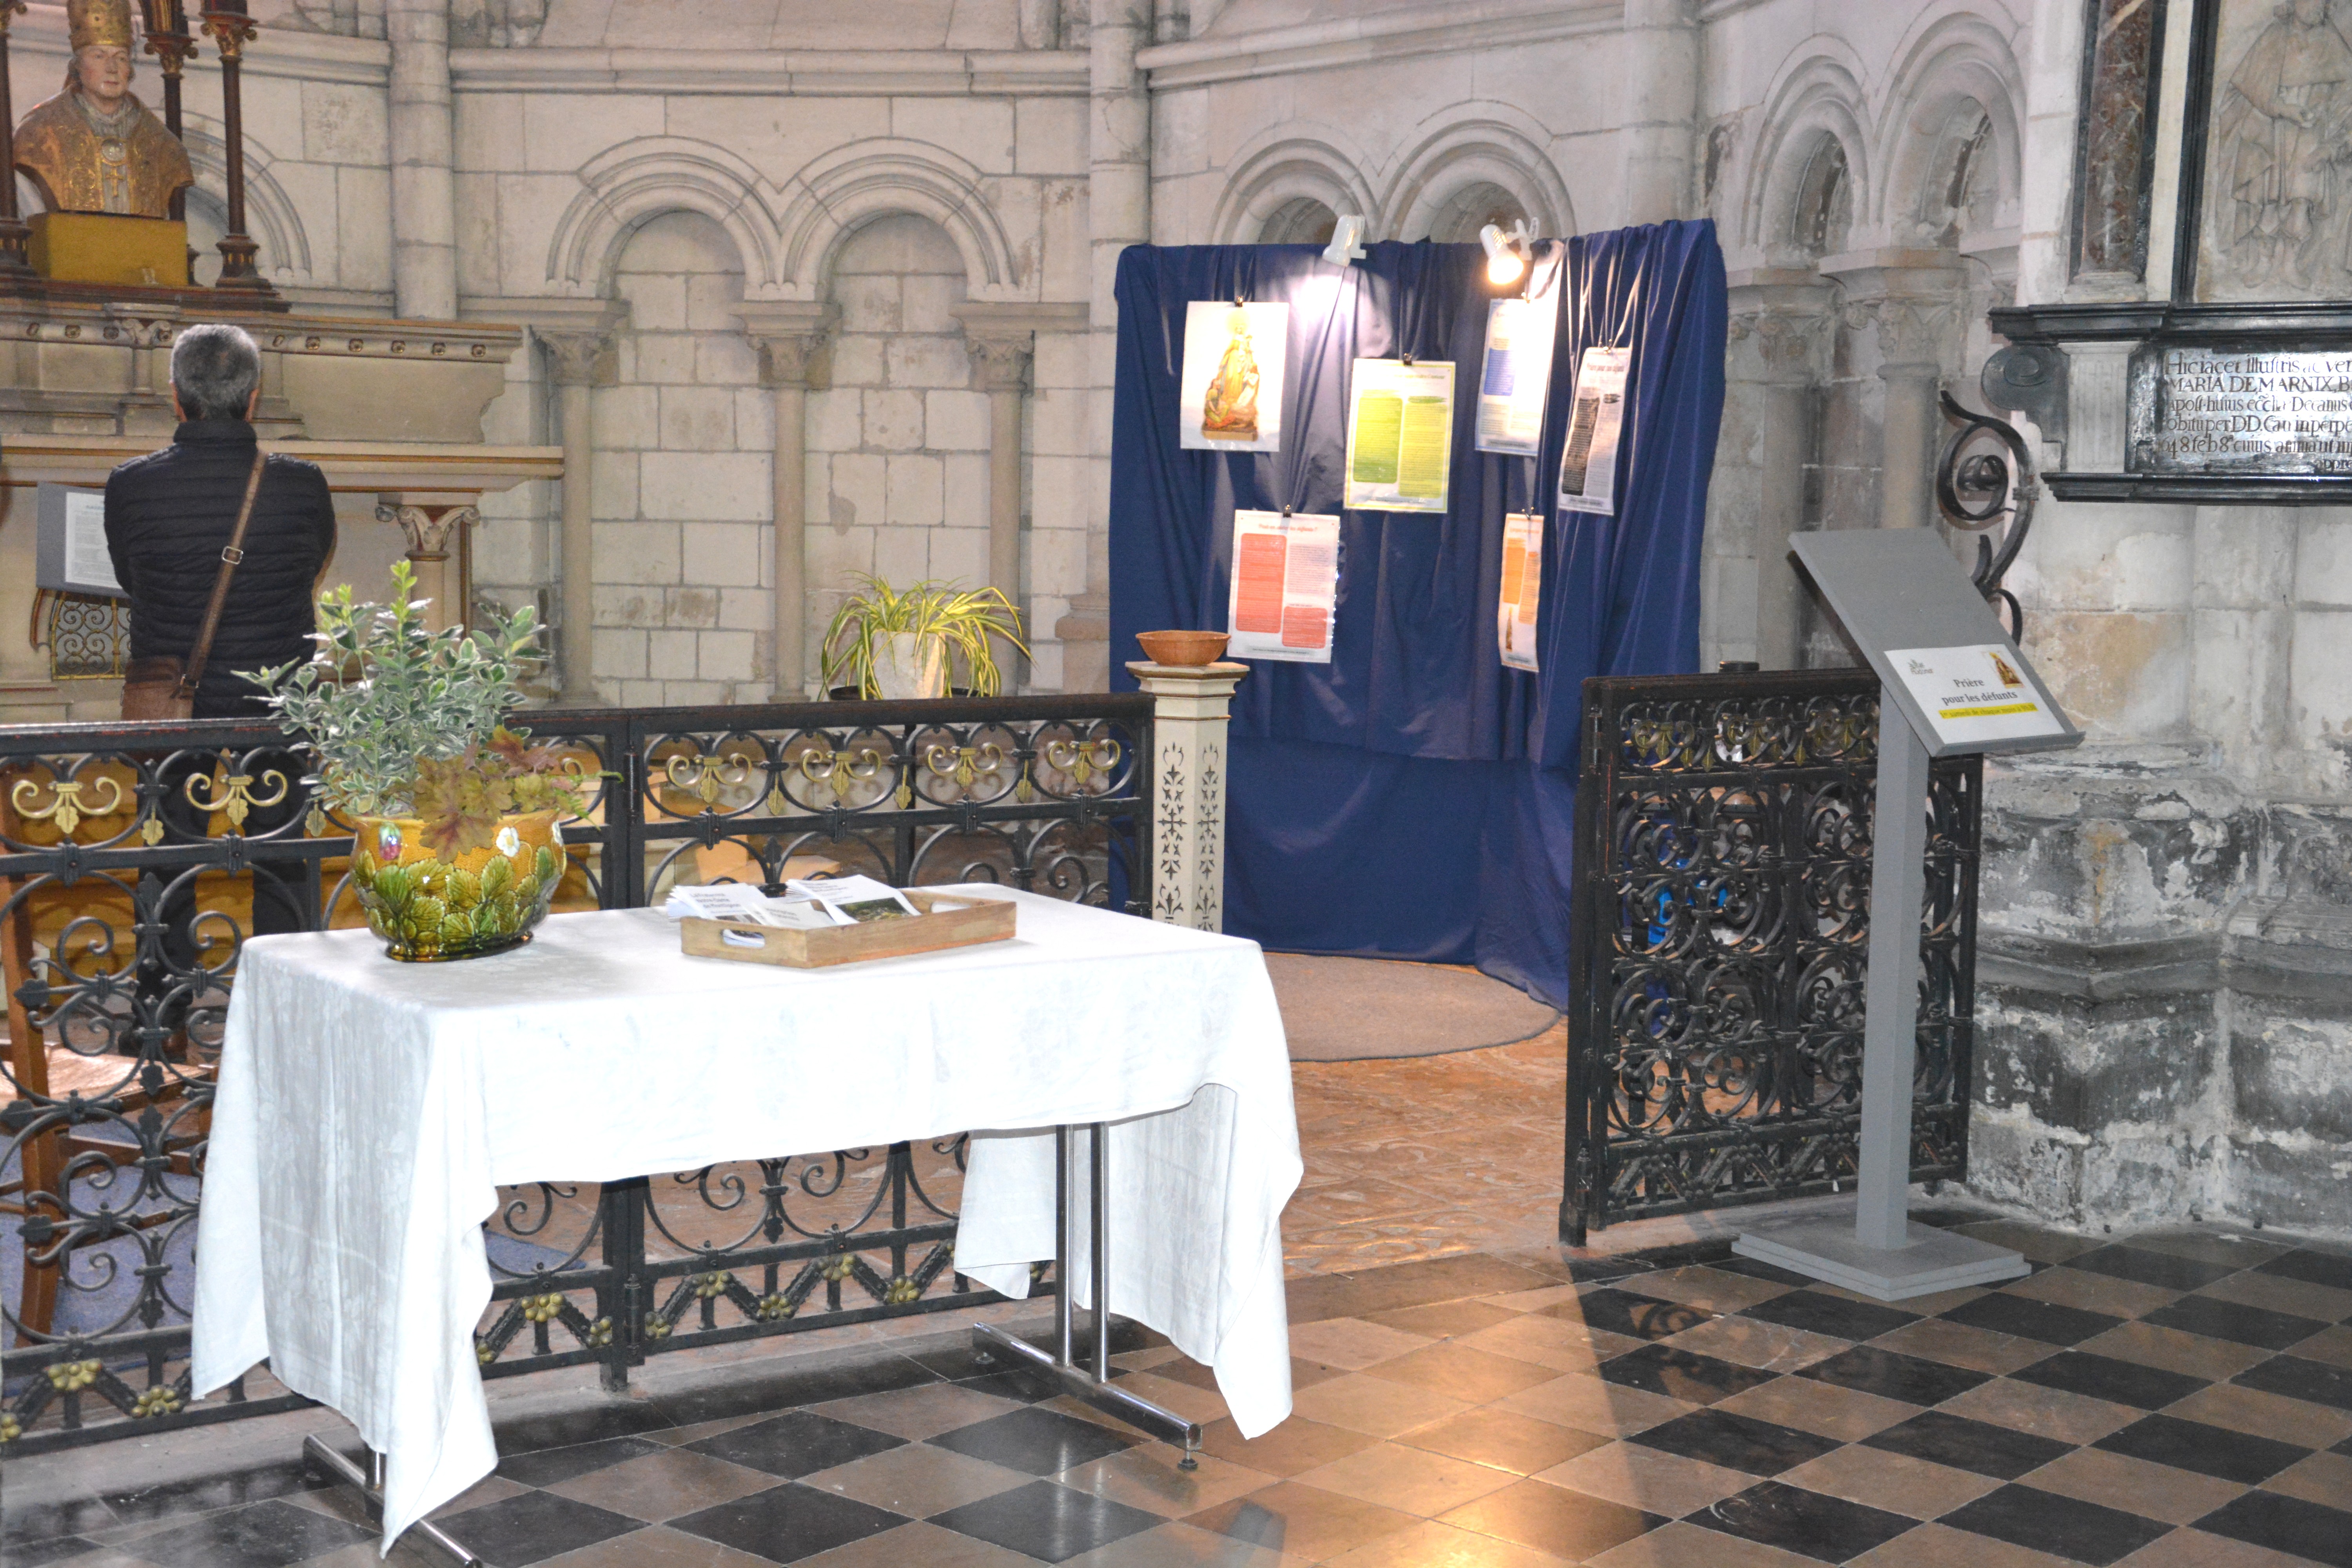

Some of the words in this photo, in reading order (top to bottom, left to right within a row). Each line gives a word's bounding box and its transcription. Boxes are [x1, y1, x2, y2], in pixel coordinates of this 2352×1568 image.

[2169, 376, 2225, 392] MARIA
[2229, 376, 2257, 392] DE
[2337, 376, 2352, 392] B
[1953, 678, 1985, 688] Prière
[1942, 696, 1965, 706] pour
[1965, 693, 1980, 702] les
[1981, 691, 2018, 701] défunts
